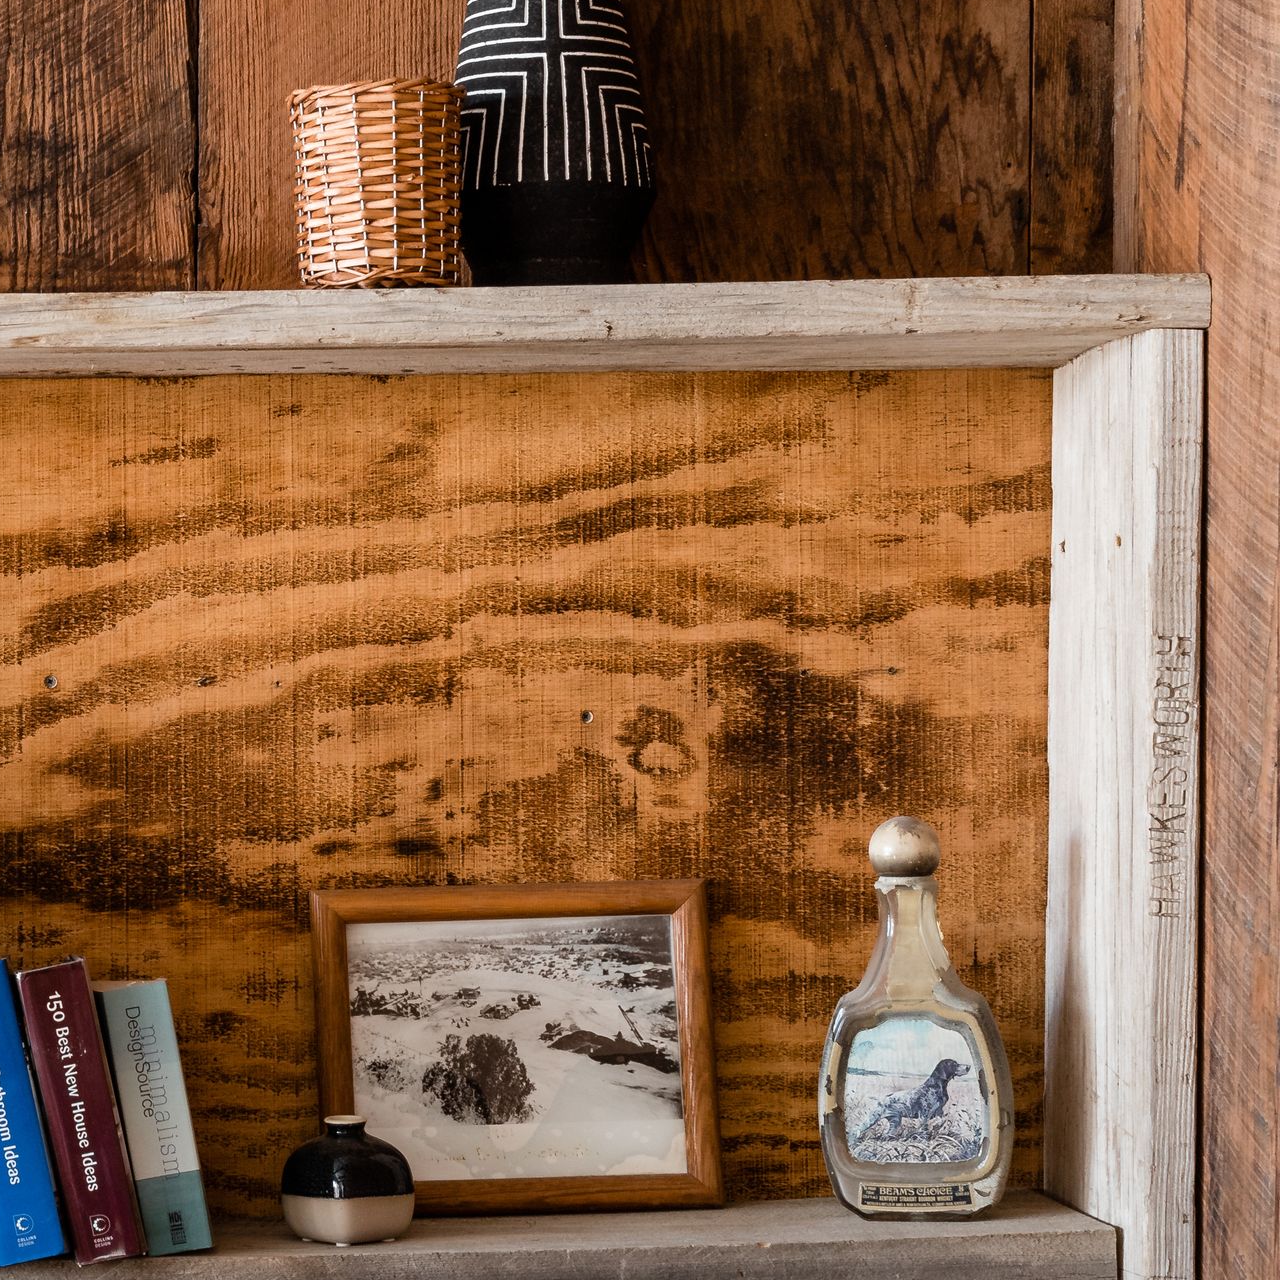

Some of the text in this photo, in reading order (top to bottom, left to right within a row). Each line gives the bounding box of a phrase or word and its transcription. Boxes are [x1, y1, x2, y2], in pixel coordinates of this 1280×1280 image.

[1148, 635, 1192, 917] HAWKESWORTH
[47, 991, 98, 1192] 150 Best New House Ideas
[142, 1023, 181, 1180] minimalism
[3, 1145, 20, 1185] Ideas
[916, 1187, 952, 1195] CHOICE
[94, 1235, 113, 1243] COLLINS
